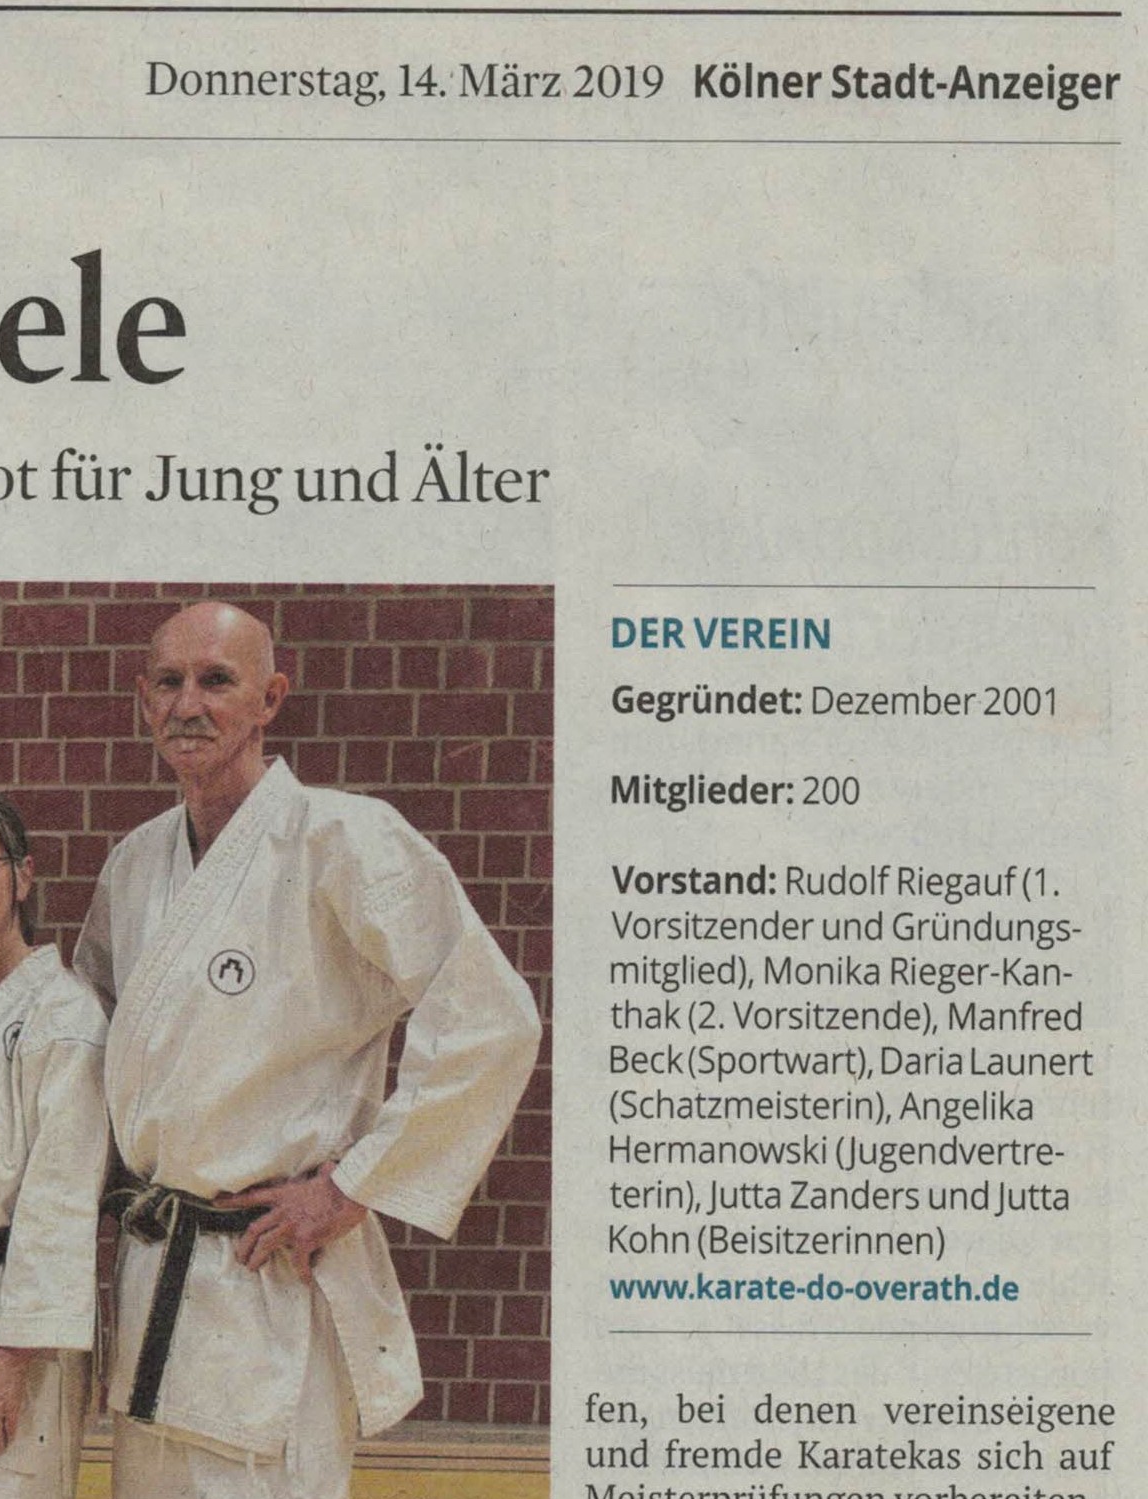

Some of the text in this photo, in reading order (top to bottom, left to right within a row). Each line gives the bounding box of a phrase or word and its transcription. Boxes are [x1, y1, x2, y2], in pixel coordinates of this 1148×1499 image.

[146, 62, 664, 107] Donnerstag, 14. März 2019
[695, 62, 1121, 111] Kölner Stadt-Anzeiger
[51, 447, 132, 501] für
[145, 455, 283, 515] Jung
[294, 450, 399, 502] und
[411, 443, 550, 503] Älter
[612, 617, 830, 649] DER VEREIN
[612, 684, 1055, 722] Gegründet: Dezember 2001
[611, 774, 860, 813] Mitglieder: 200
[612, 864, 1059, 905] Vorstand: Rudolf Riegauf (1.
[611, 910, 1081, 950] Vorsitzender und Gründungs-
[611, 954, 1072, 994] mitglied), Monika Rieger-Kan-
[611, 999, 1082, 1036] thak (2. Vorsitzende), Manfred
[610, 1044, 1093, 1083] Beck (Sportwart), Daria Launert
[610, 1089, 1033, 1129] (Schatzmeisterin), Angelika
[610, 1134, 1064, 1173] Hermanowski (Jugendvertre-
[610, 1179, 1069, 1217] terin), Jutta Zanders und Jutta
[609, 1223, 945, 1261] Kohn (Beisitzerinnen)
[610, 1272, 1019, 1301] www.karate-do-overath.de
[586, 1438, 1115, 1470] und fremde Karatekas sich auf
